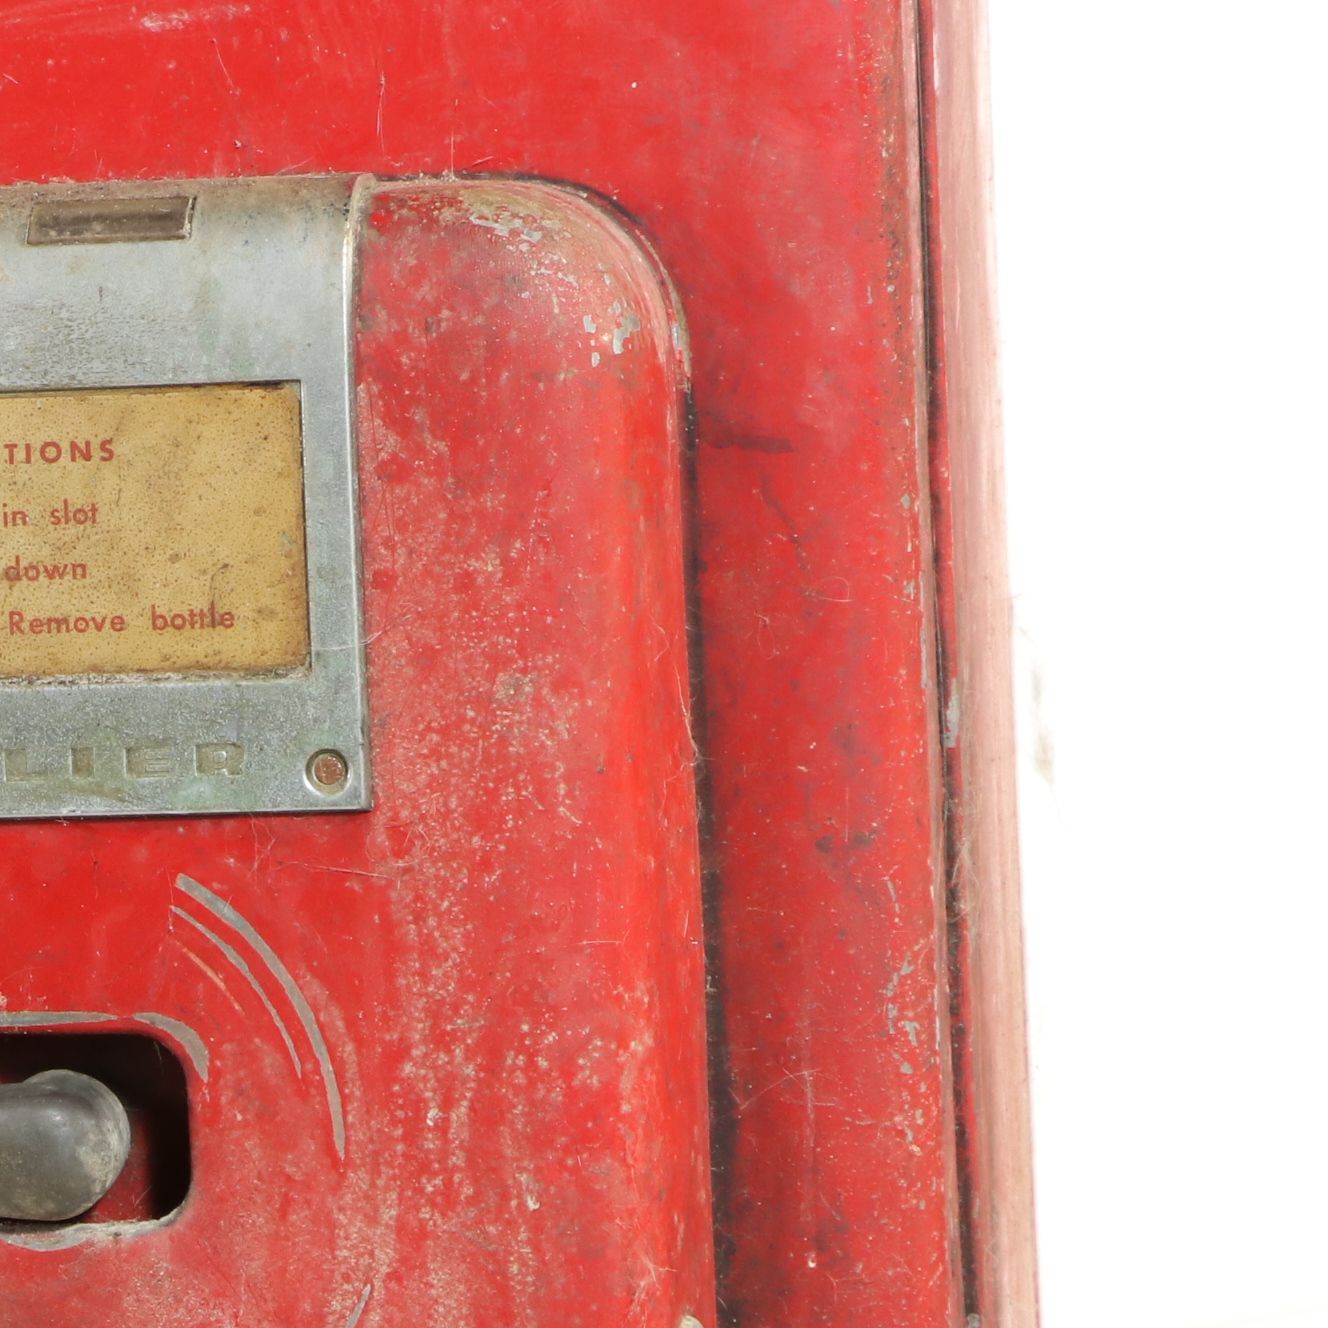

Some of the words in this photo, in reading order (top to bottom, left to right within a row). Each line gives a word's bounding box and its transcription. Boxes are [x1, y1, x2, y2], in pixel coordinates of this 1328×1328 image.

[2, 502, 30, 528] in
[49, 498, 99, 526] slot
[3, 554, 89, 583] down
[8, 610, 128, 636] Remove
[150, 600, 236, 632] bottle
